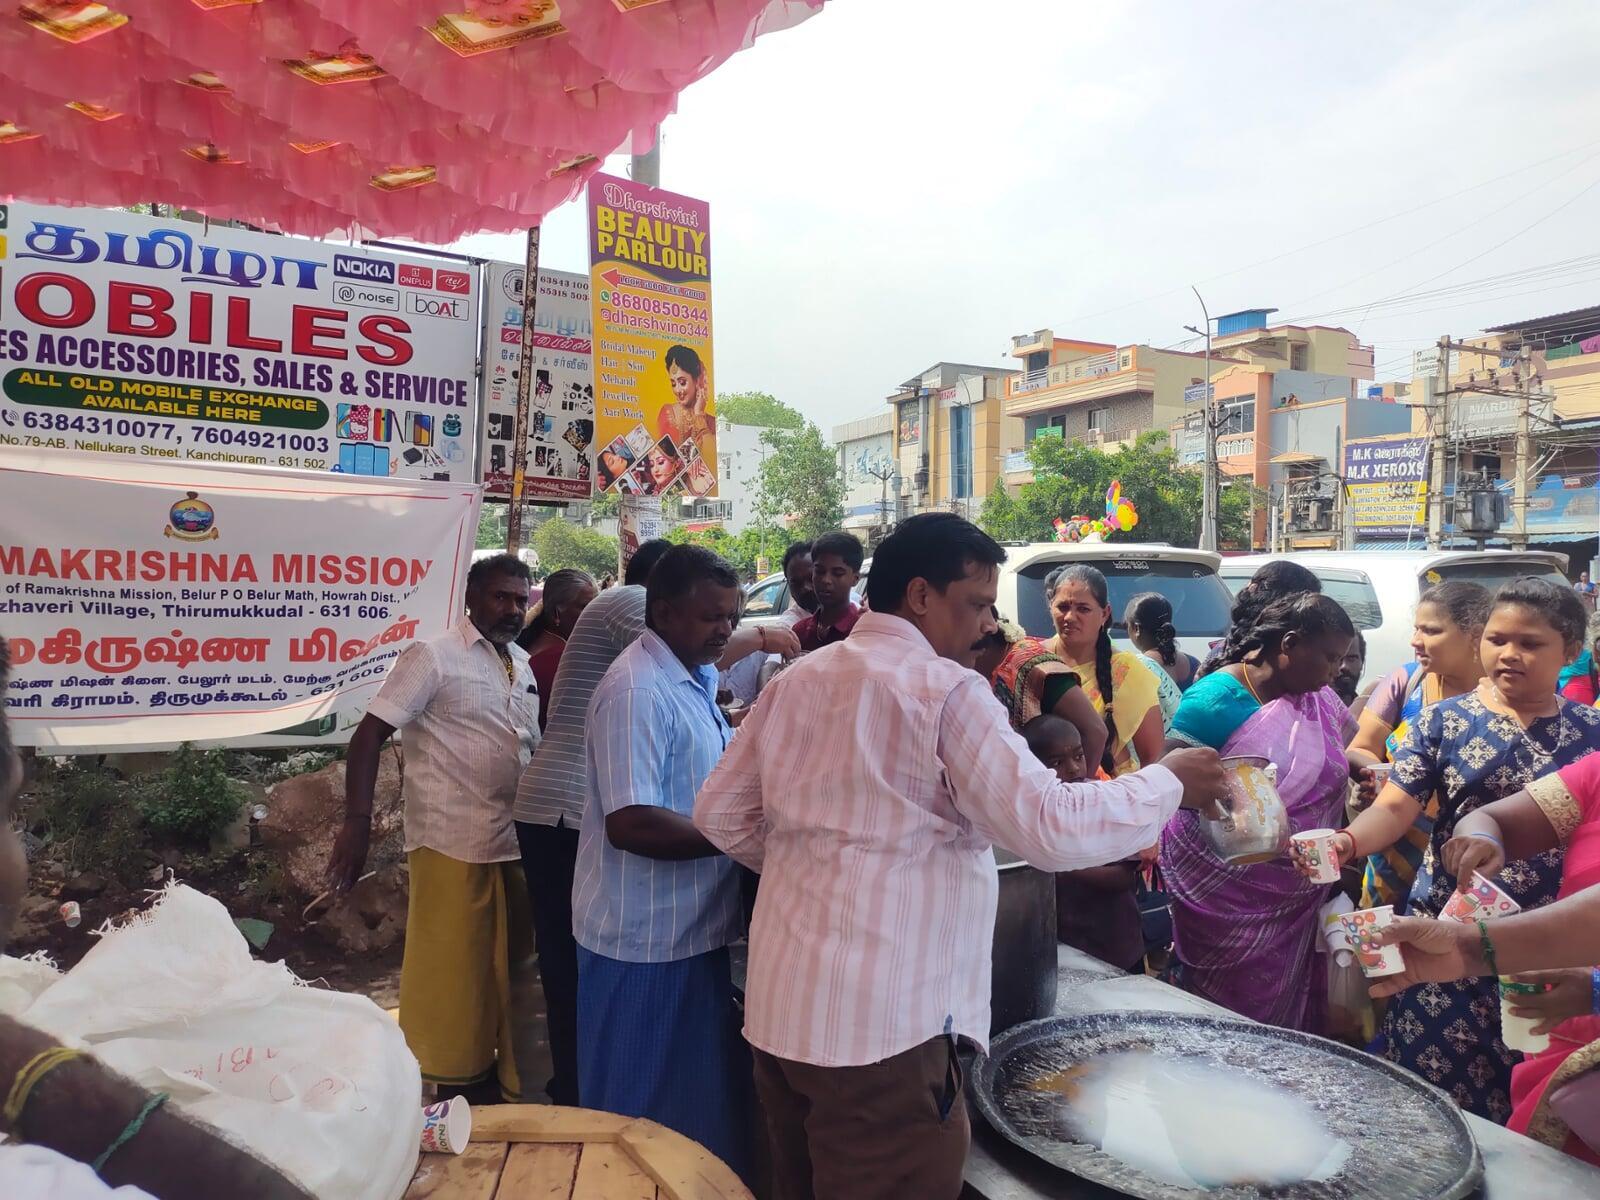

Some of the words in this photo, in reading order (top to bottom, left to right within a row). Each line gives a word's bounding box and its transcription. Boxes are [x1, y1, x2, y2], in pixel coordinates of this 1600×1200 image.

[604, 183, 699, 228] Dharshvini
[597, 206, 705, 254] BEAUTY
[15, 221, 327, 290] தமிழா
[336, 258, 392, 279] NOKIA
[597, 231, 708, 276] PARLOUR
[0, 270, 413, 366] OBILES
[611, 292, 708, 322] 8680850344
[36, 333, 245, 387] ACCESSORIES,
[253, 357, 333, 393] SALES
[339, 371, 359, 396] &
[365, 369, 468, 407] SERVICE
[18, 371, 62, 388] ALL
[69, 376, 114, 393] OLD
[121, 382, 203, 401] MOBILE
[209, 390, 318, 412] EXCHANGE
[82, 394, 200, 416] AVAILABLE
[206, 405, 261, 422] HERE
[23, 412, 182, 444] 6384310077,
[191, 425, 329, 453] 7604921003
[74, 439, 136, 455] Nellukara
[186, 449, 266, 464] Kanchipuram
[278, 455, 299, 467] 631
[1352, 448, 1372, 461] M.K
[1347, 464, 1370, 480] M.K
[273, 553, 434, 587] MISSION
[6, 583, 21, 594] of
[25, 583, 115, 599] Ramakrishna
[120, 589, 177, 601] Mission,
[181, 589, 217, 600] Belur
[220, 589, 229, 600] P
[233, 589, 243, 600] O
[248, 590, 281, 601] Belur
[284, 590, 318, 603] Math,
[322, 590, 367, 601] Howrah
[80, 601, 156, 619] Village,
[162, 604, 303, 618] Thirumukkudal
[320, 605, 350, 617] 631
[310, 680, 344, 697] 631
